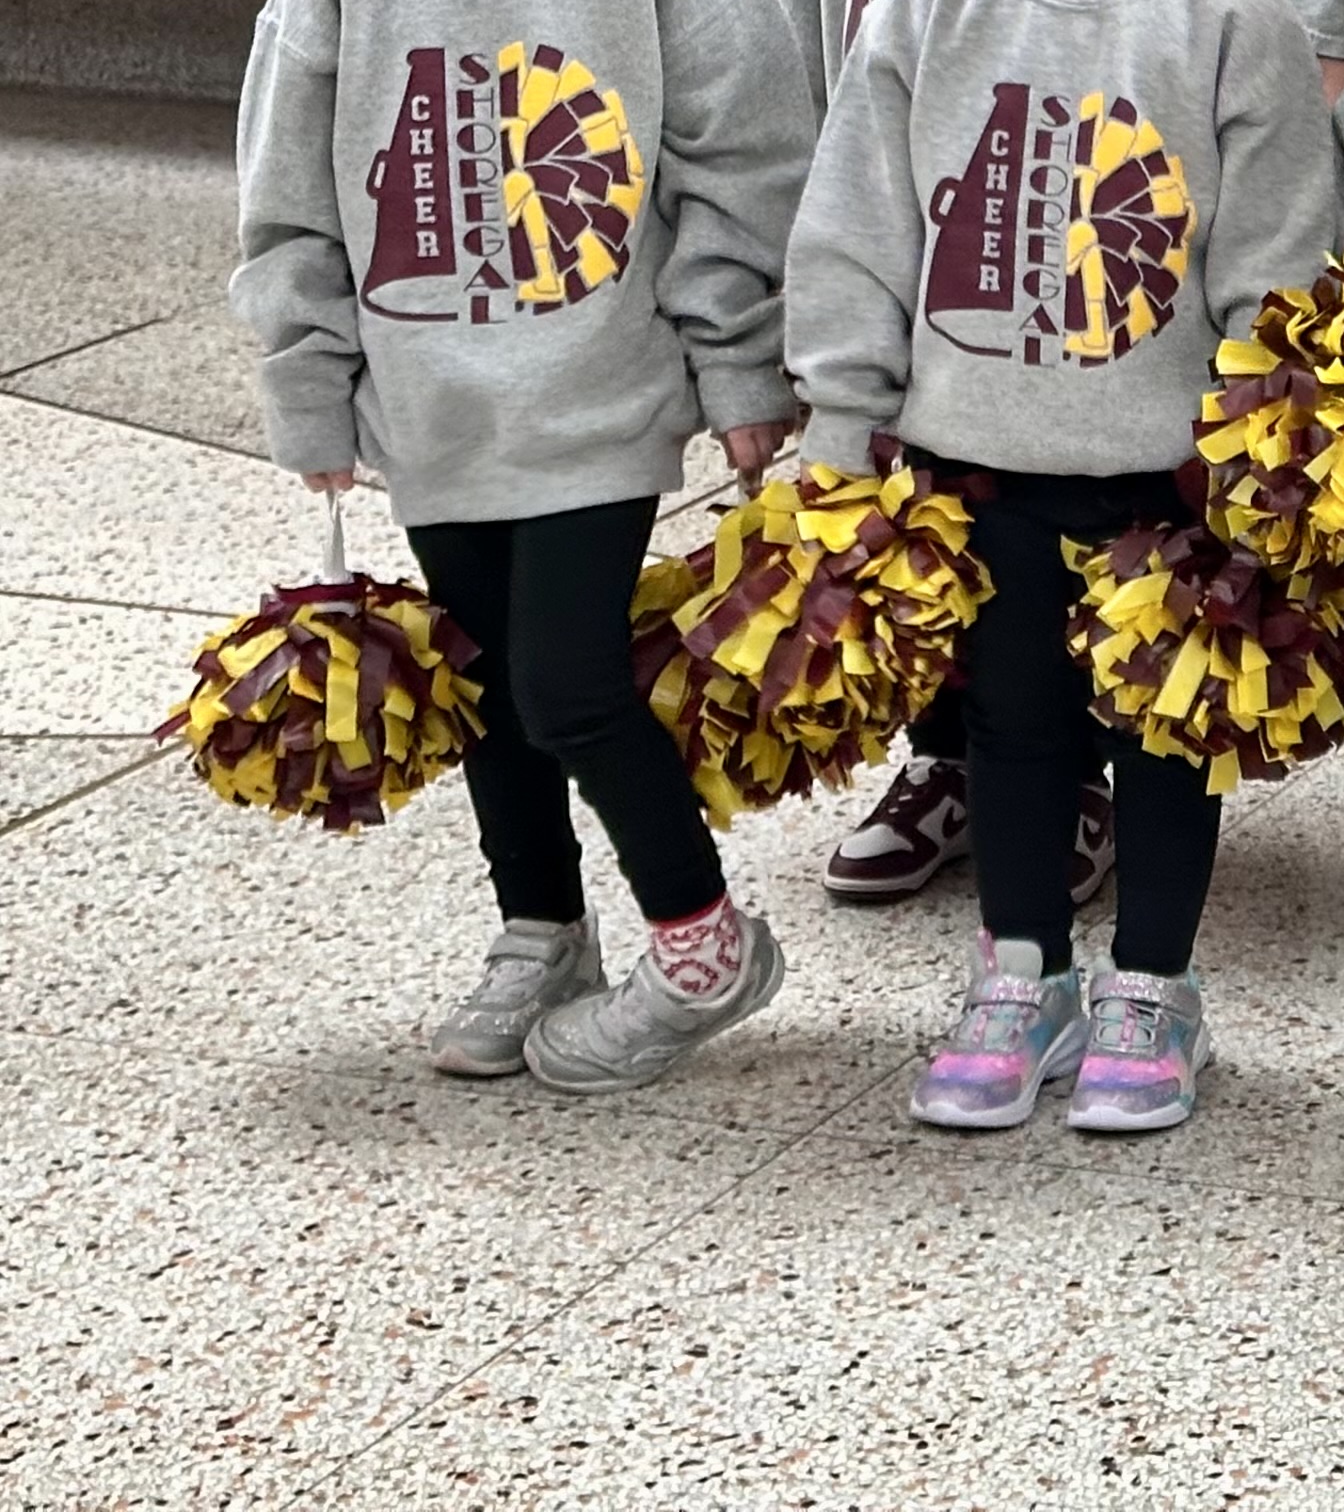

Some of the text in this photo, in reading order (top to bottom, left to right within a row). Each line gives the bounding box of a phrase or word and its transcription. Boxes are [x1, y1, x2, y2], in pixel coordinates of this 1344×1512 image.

[410, 94, 440, 258] CHEER
[456, 53, 511, 325] SHOREGAL
[978, 129, 1010, 292] CHEER
[1019, 95, 1072, 368] SHOREGAL
